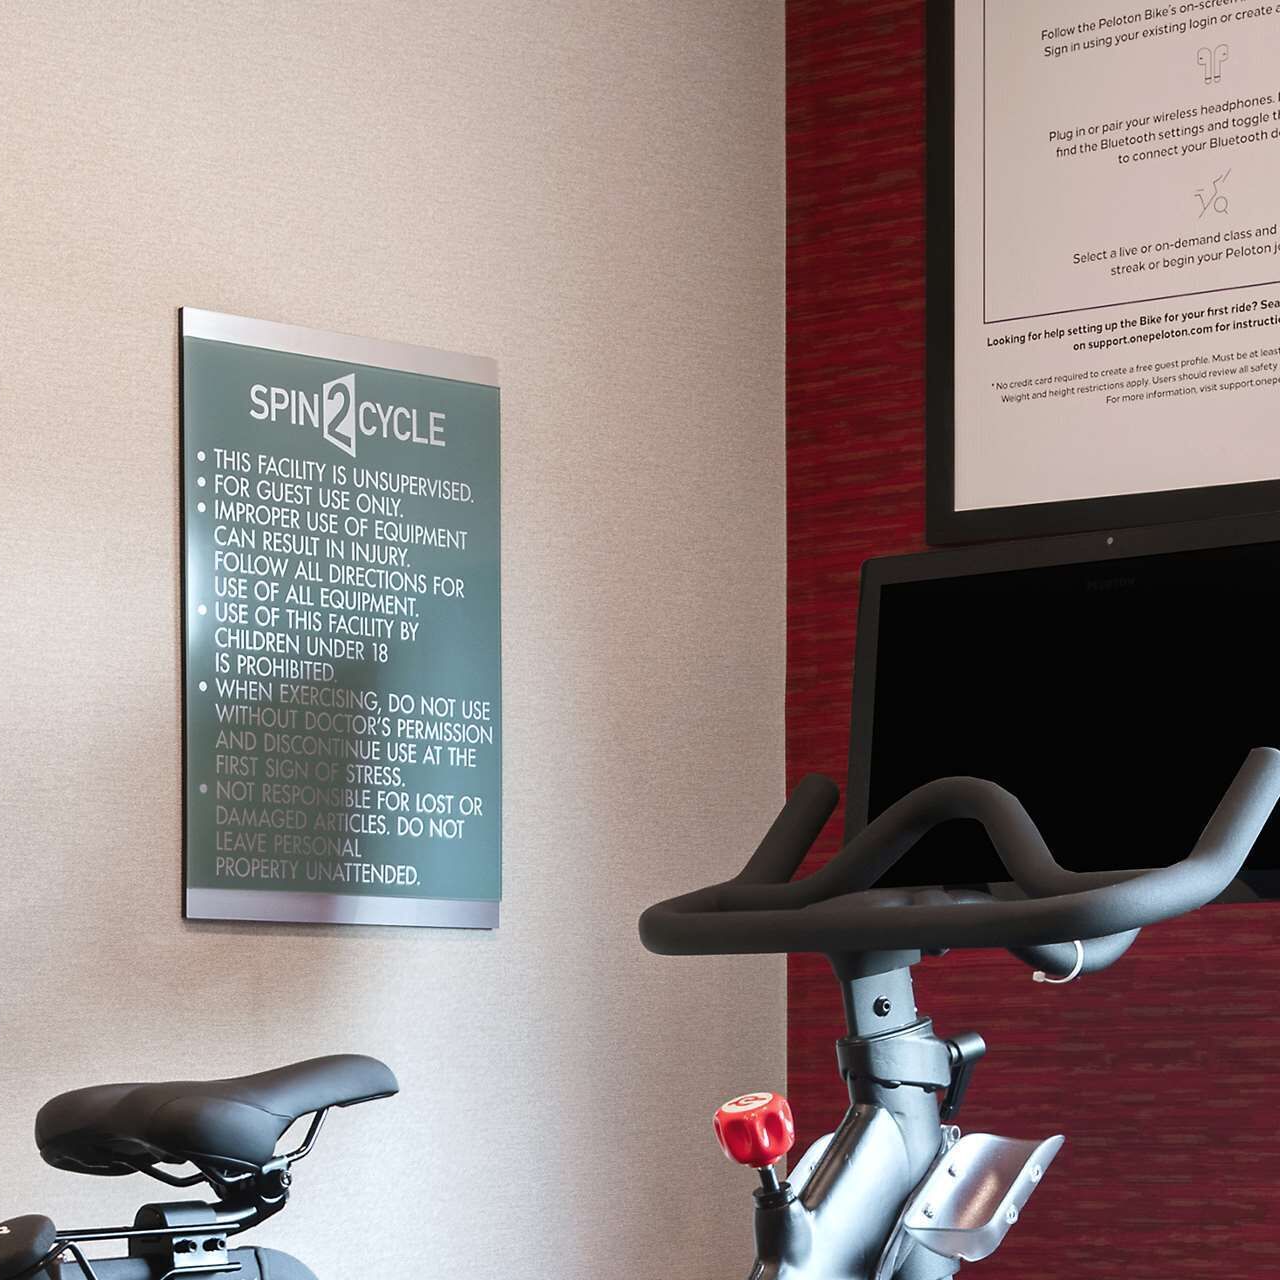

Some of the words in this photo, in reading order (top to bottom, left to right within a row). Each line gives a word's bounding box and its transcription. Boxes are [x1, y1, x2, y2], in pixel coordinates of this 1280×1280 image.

[1041, 26, 1076, 40] Follow
[1077, 22, 1097, 33] the
[1098, 13, 1142, 29] Peloton
[1044, 45, 1069, 58] Sign
[1082, 36, 1113, 49] using
[1114, 31, 1140, 46] your
[1142, 22, 1187, 37] existing
[1189, 15, 1218, 30] login
[1234, 5, 1273, 20] create
[1049, 130, 1074, 142] Plug
[1102, 119, 1123, 135] pair
[1125, 116, 1151, 130] your
[1152, 108, 1198, 123] wireless
[1056, 144, 1077, 157] find
[1100, 131, 1156, 150] Bluetooth
[1158, 124, 1205, 140] settings
[1207, 117, 1229, 131] and
[1231, 112, 1270, 128] toggle
[1132, 145, 1179, 161] connect
[1181, 141, 1208, 156] your
[1209, 129, 1268, 148] Bluetooth
[1072, 250, 1108, 264] Select
[1119, 246, 1138, 256] live
[1154, 231, 1221, 251] on-demand
[1223, 229, 1253, 241] class
[1254, 223, 1278, 237] and
[1110, 261, 1146, 275] streak
[1162, 255, 1195, 268] begin
[1197, 251, 1224, 265] your
[1225, 244, 1272, 258] Peloton
[987, 334, 1026, 346] Looking
[1027, 331, 1043, 341] for
[1043, 327, 1065, 339] help
[1067, 323, 1103, 336] setting
[1139, 315, 1162, 325] Bike
[1164, 312, 1179, 322] for
[1181, 310, 1206, 322] your
[1206, 305, 1229, 316] first
[1231, 300, 1258, 313] ride?
[1088, 325, 1213, 349] support.onepeloton.com
[1215, 321, 1231, 332] for
[213, 447, 251, 472] THIS
[258, 454, 326, 482] FACILITY
[332, 464, 346, 485] IS
[353, 467, 474, 503] UNSUPERVISED.
[214, 473, 250, 498] FOR
[256, 479, 312, 505] GUEST
[319, 487, 349, 510] USE
[356, 492, 403, 517] ONLY.
[214, 499, 300, 529] IMPROPER
[306, 510, 337, 534] USE
[344, 516, 368, 536] OF
[374, 519, 467, 549] EQUIPMENT
[213, 525, 255, 549] CAN
[262, 530, 320, 556] RESULT
[326, 538, 344, 559] IN
[351, 541, 410, 567] INJURY.
[214, 550, 288, 577] FOLLOW
[294, 559, 323, 582] ALL
[329, 563, 426, 594] DIRECTIONS
[433, 575, 464, 598] FOR
[214, 575, 247, 598] USE
[253, 580, 279, 601] OF
[284, 583, 314, 606] ALL
[320, 587, 418, 617] EQUIPMENT.
[215, 601, 248, 625] USE
[254, 605, 279, 627] OF
[285, 608, 322, 632] THIS
[328, 613, 394, 638] FACILITY
[400, 620, 419, 641] BY
[214, 626, 299, 654] CHILDREN
[306, 635, 364, 660] UNDER
[372, 642, 388, 662] 18
[215, 651, 230, 673] IS
[237, 653, 336, 681] PROHIBITED.
[215, 677, 272, 701] WHEN
[280, 683, 381, 713] EXERCISING,
[388, 693, 414, 714] DO
[420, 695, 456, 717] NOT
[462, 700, 490, 720] USE
[214, 703, 298, 728] WITHOUT
[397, 718, 492, 744] PERMISSION
[215, 729, 256, 751] AND
[264, 732, 380, 760] DISCONTINUE
[387, 741, 416, 763] USE
[422, 744, 442, 765] AT
[447, 746, 476, 767] THE
[216, 754, 258, 776] FIRST
[265, 757, 308, 779] SIGN
[314, 760, 337, 781] OF
[346, 764, 405, 787] STRESS.
[216, 780, 255, 801] NOT
[261, 783, 370, 808] RESPONSIBLE
[377, 790, 409, 811] FOR
[415, 792, 454, 814] LOST
[459, 795, 482, 816] OR
[216, 804, 306, 829] DAMAGED
[313, 811, 389, 835] ARTICLES.
[397, 815, 423, 837] DO
[429, 817, 464, 838] NOT
[216, 831, 266, 852] LEAVE
[274, 834, 361, 857] PERSONAL
[215, 856, 298, 879] PROPERTY
[305, 861, 420, 885] UNATTENDED.
